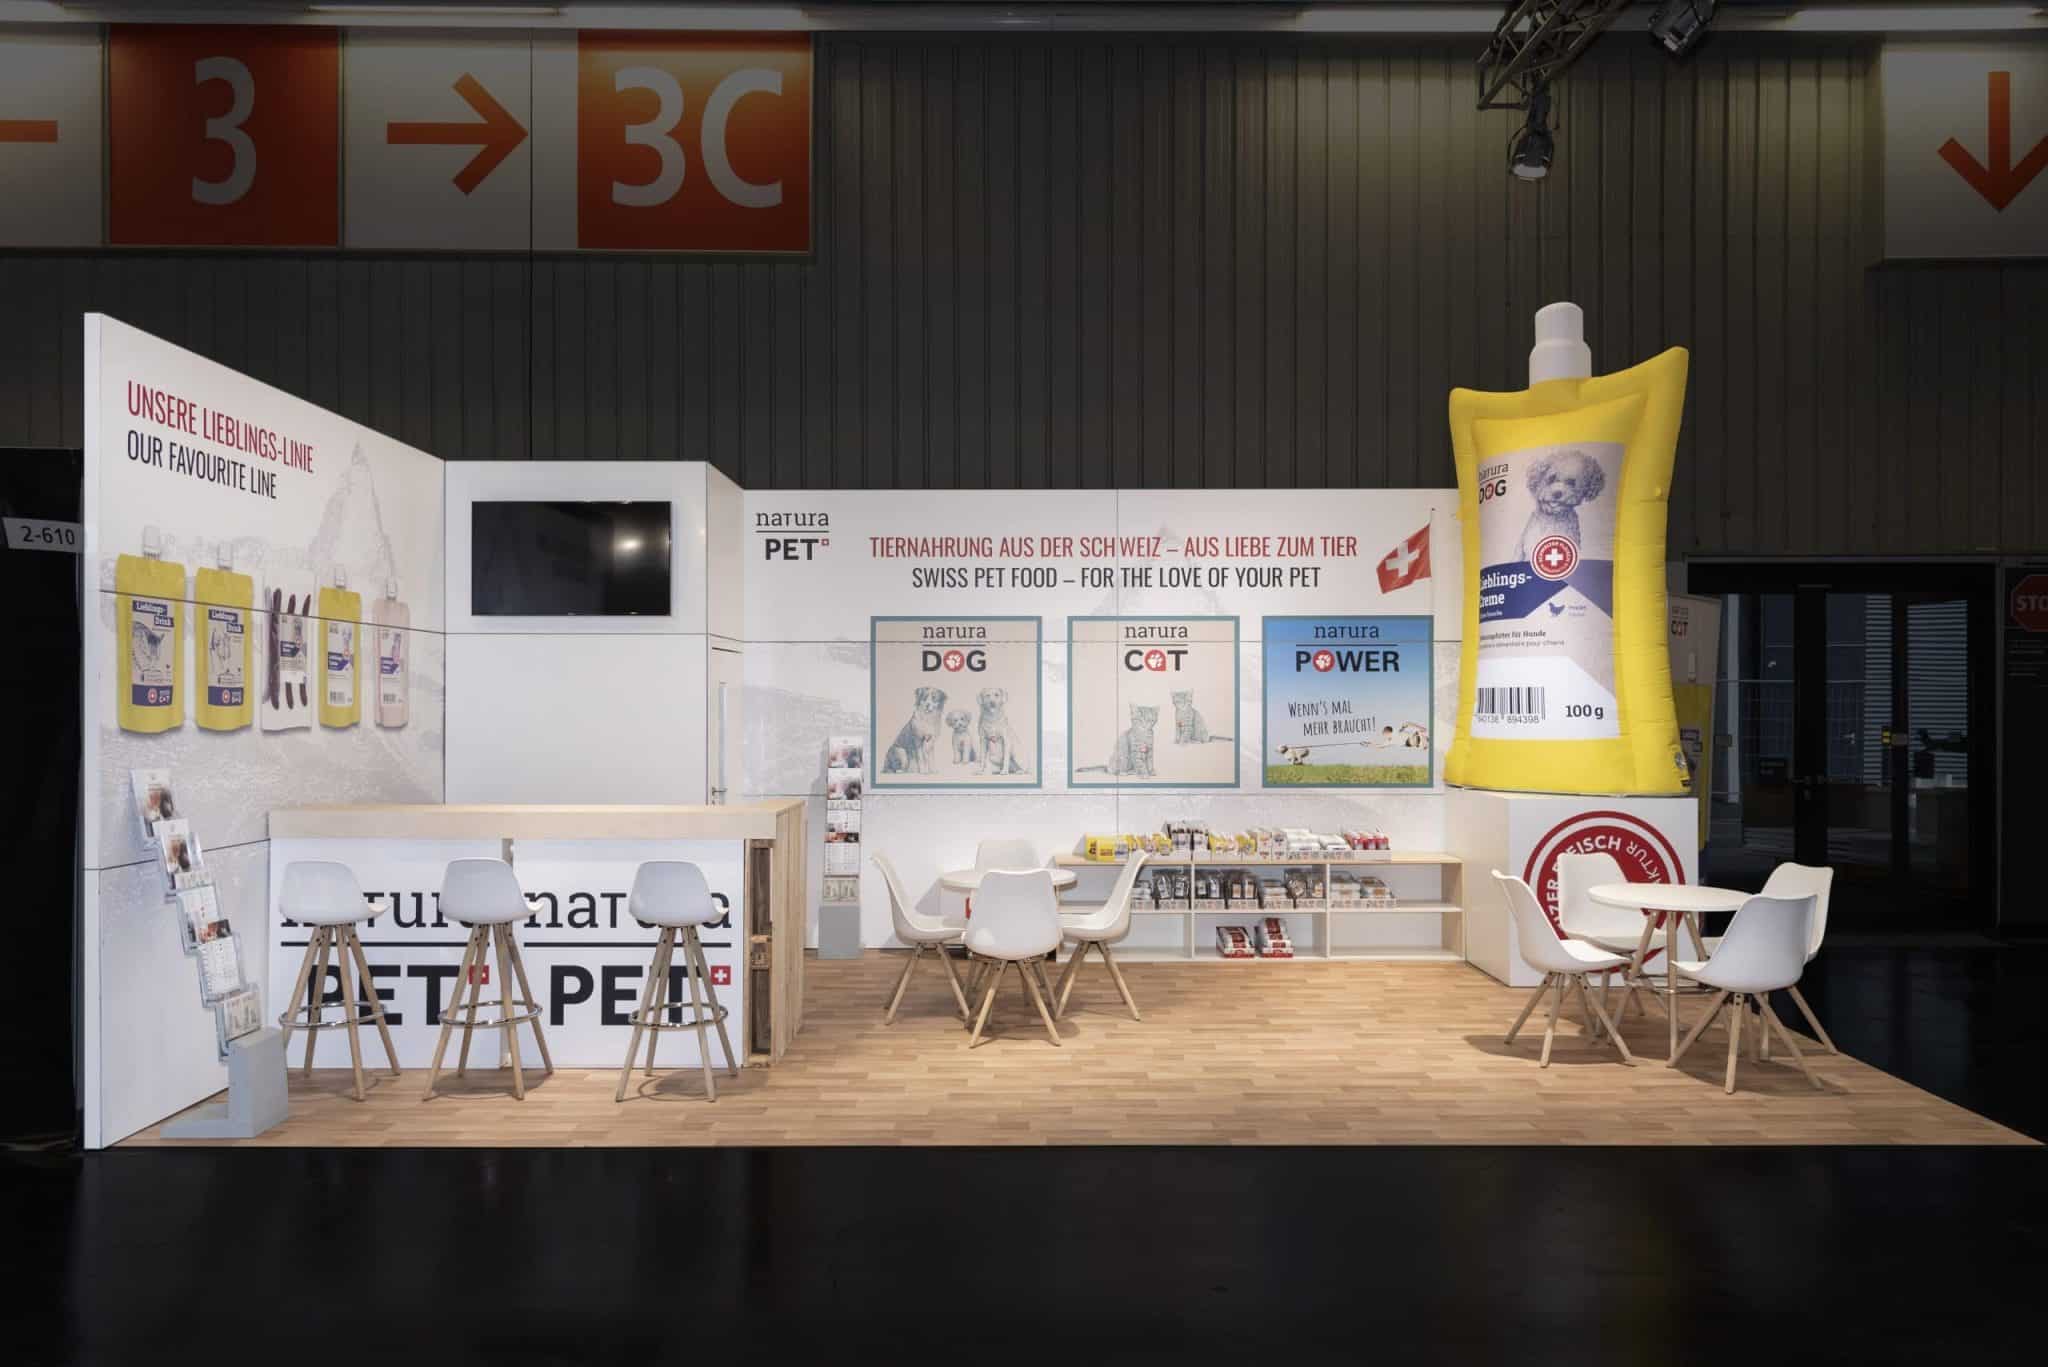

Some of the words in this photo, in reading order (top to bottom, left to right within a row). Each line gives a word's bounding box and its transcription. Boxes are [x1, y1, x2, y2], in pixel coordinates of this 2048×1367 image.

[191, 56, 257, 207] 3
[611, 67, 784, 209] 3C
[128, 379, 197, 436] UNSERE
[203, 407, 314, 474] LIEBLINGS-LINIE
[127, 429, 163, 468] OUR
[169, 441, 246, 491] FAVOURITE
[250, 466, 277, 500] LINE
[756, 512, 830, 527] natura
[20, 525, 75, 545] 2-610
[765, 538, 819, 561] PET
[870, 536, 993, 558] TIERNAHRUNG
[999, 536, 1034, 558] AUS
[1041, 536, 1074, 558] DER
[1080, 536, 1162, 558] SCHWEIZ
[1184, 536, 1219, 558] AUS
[1225, 536, 1271, 557] LIEBE
[1277, 536, 1314, 557] ZUM
[1320, 536, 1358, 557] TIER
[912, 567, 969, 589] SWISS
[975, 567, 1003, 588] PET
[1011, 567, 1058, 588] FOOD
[1081, 567, 1114, 588] FOR
[1121, 567, 1152, 588] THE
[1159, 567, 1202, 588] LOVE
[1208, 567, 1230, 588] OF
[1236, 567, 1283, 588] YOUR
[1289, 567, 1321, 588] PET
[922, 625, 987, 639] natura
[1125, 625, 1189, 639] natura
[1314, 625, 1380, 639] natura
[921, 649, 987, 672] DOG
[1295, 649, 1400, 673] POWER
[1565, 704, 1592, 718] 100
[1594, 705, 1604, 720] g
[1333, 716, 1376, 735] BRAUCHT!
[307, 965, 461, 1026] PET
[549, 965, 702, 1026] PET
